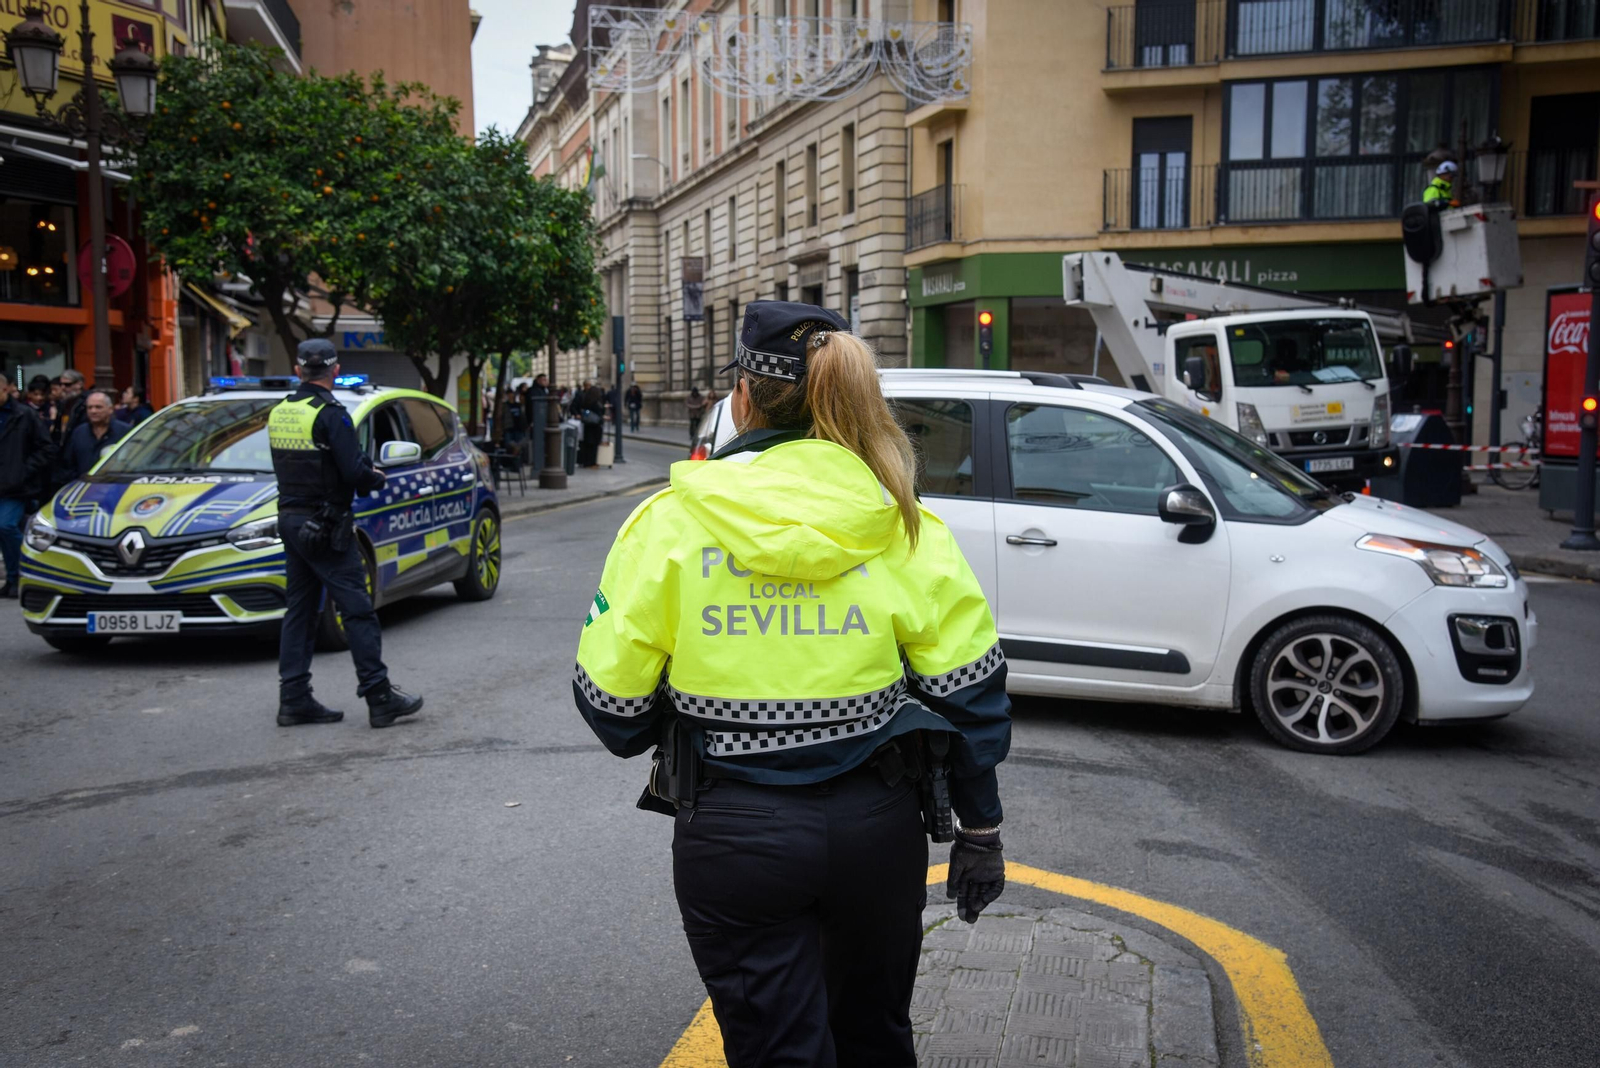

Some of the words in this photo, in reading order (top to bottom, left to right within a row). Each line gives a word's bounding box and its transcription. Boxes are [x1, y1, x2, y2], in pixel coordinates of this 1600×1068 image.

[1139, 260, 1251, 283] SAKALI
[1257, 269, 1298, 284] pizza
[389, 505, 432, 532] POLICÍA
[433, 500, 467, 520] LOCAL
[750, 582, 821, 599] LOCAL
[98, 615, 138, 630] 0958
[143, 614, 175, 630] LJZ
[701, 604, 870, 636] SEVILLA
